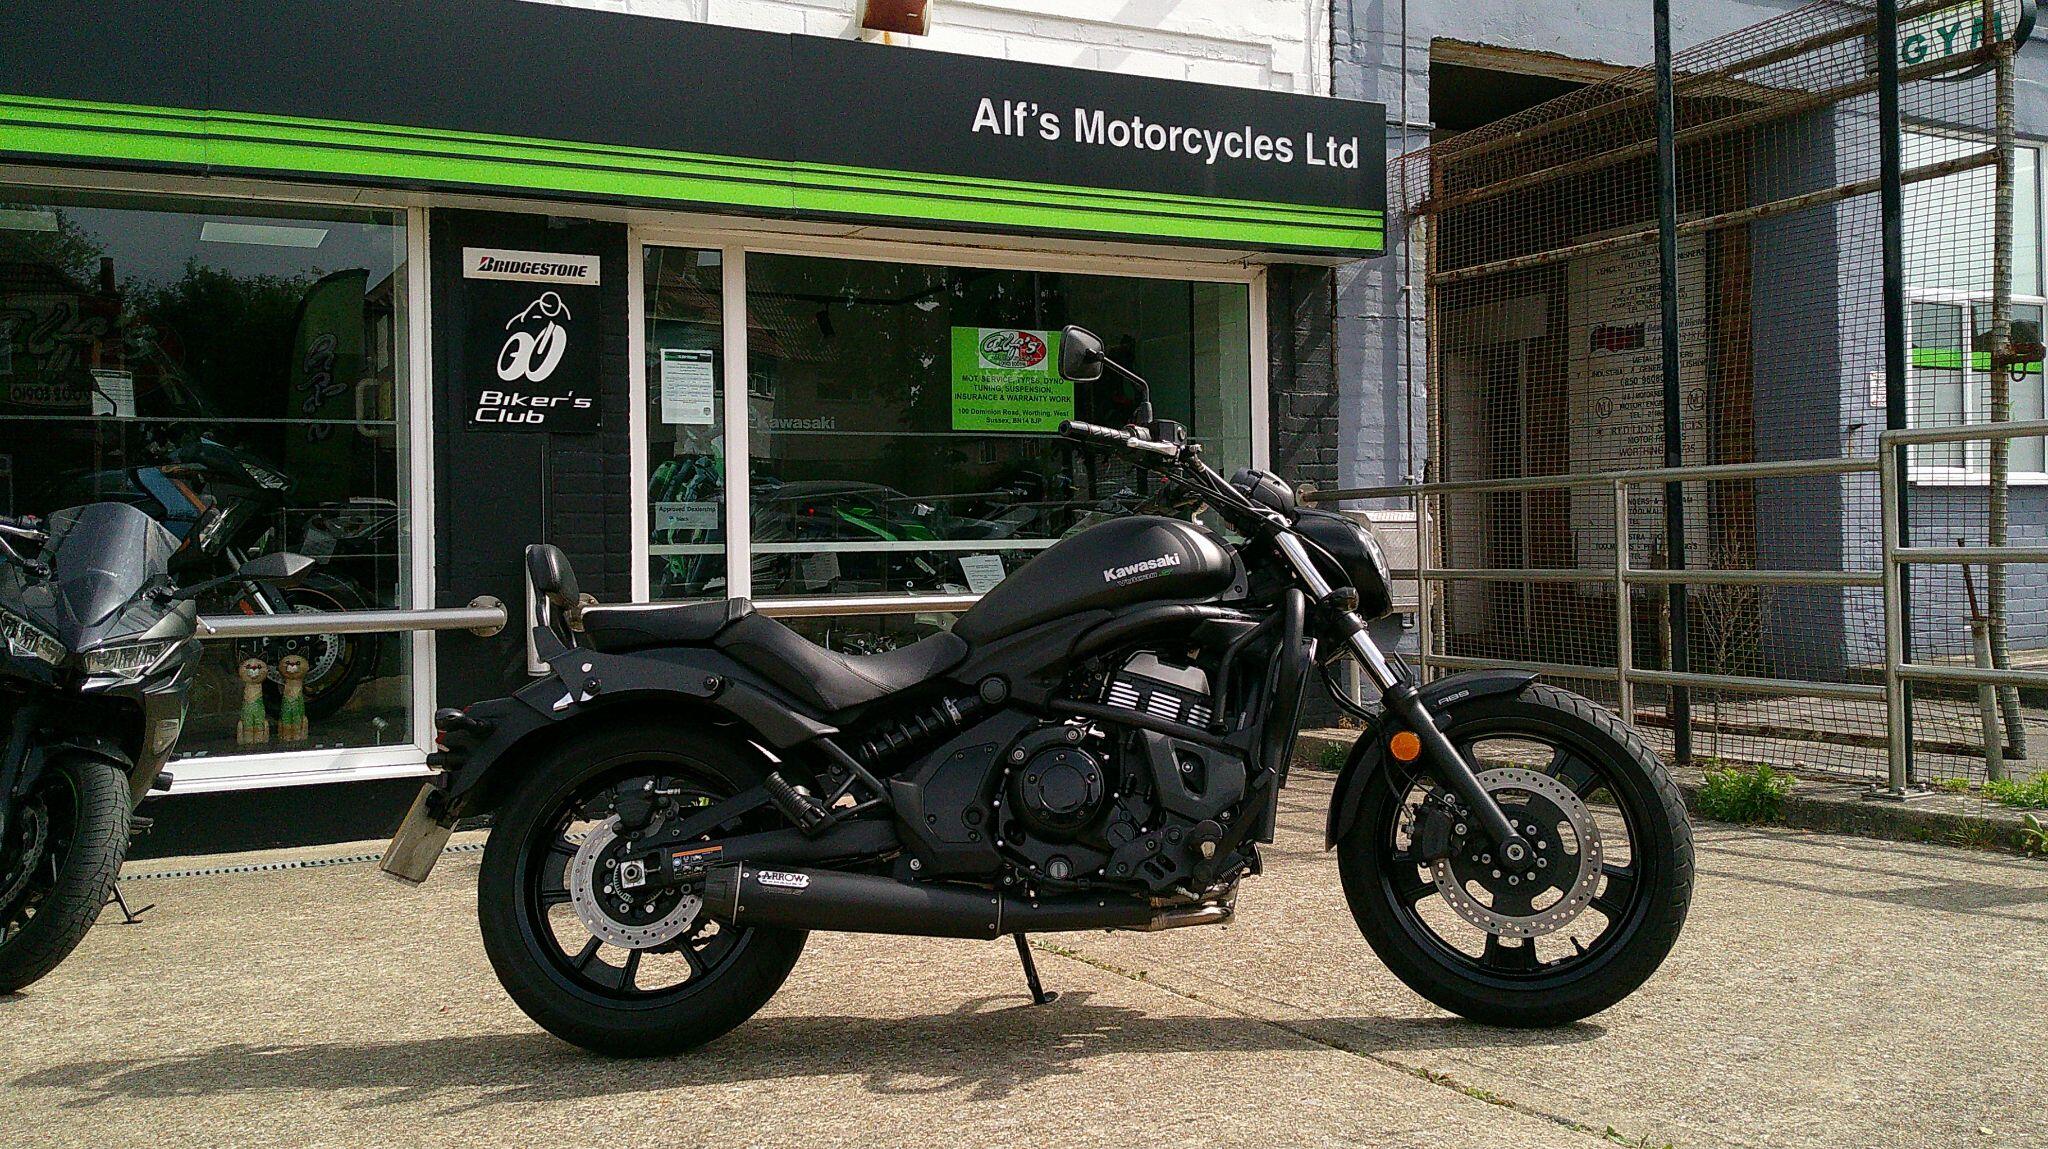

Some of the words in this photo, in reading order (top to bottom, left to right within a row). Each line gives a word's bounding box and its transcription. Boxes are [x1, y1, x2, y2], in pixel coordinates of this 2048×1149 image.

[971, 98, 1061, 141] Alf's
[1074, 108, 1295, 165] Motorcycles
[1306, 132, 1360, 170] Ltd
[477, 256, 588, 278] BRIDGESTONE
[973, 384, 1004, 393] TUNING,
[1044, 377, 1065, 385] DYNO
[479, 389, 593, 409] Biker's
[954, 392, 998, 401] INSURANCE
[1006, 394, 1048, 403] WARRANTY
[1049, 395, 1072, 403] WORK
[475, 407, 545, 424] Club
[1103, 552, 1181, 582] Kawasaki
[1438, 689, 1470, 706] ABS
[761, 871, 805, 882] ARROW
